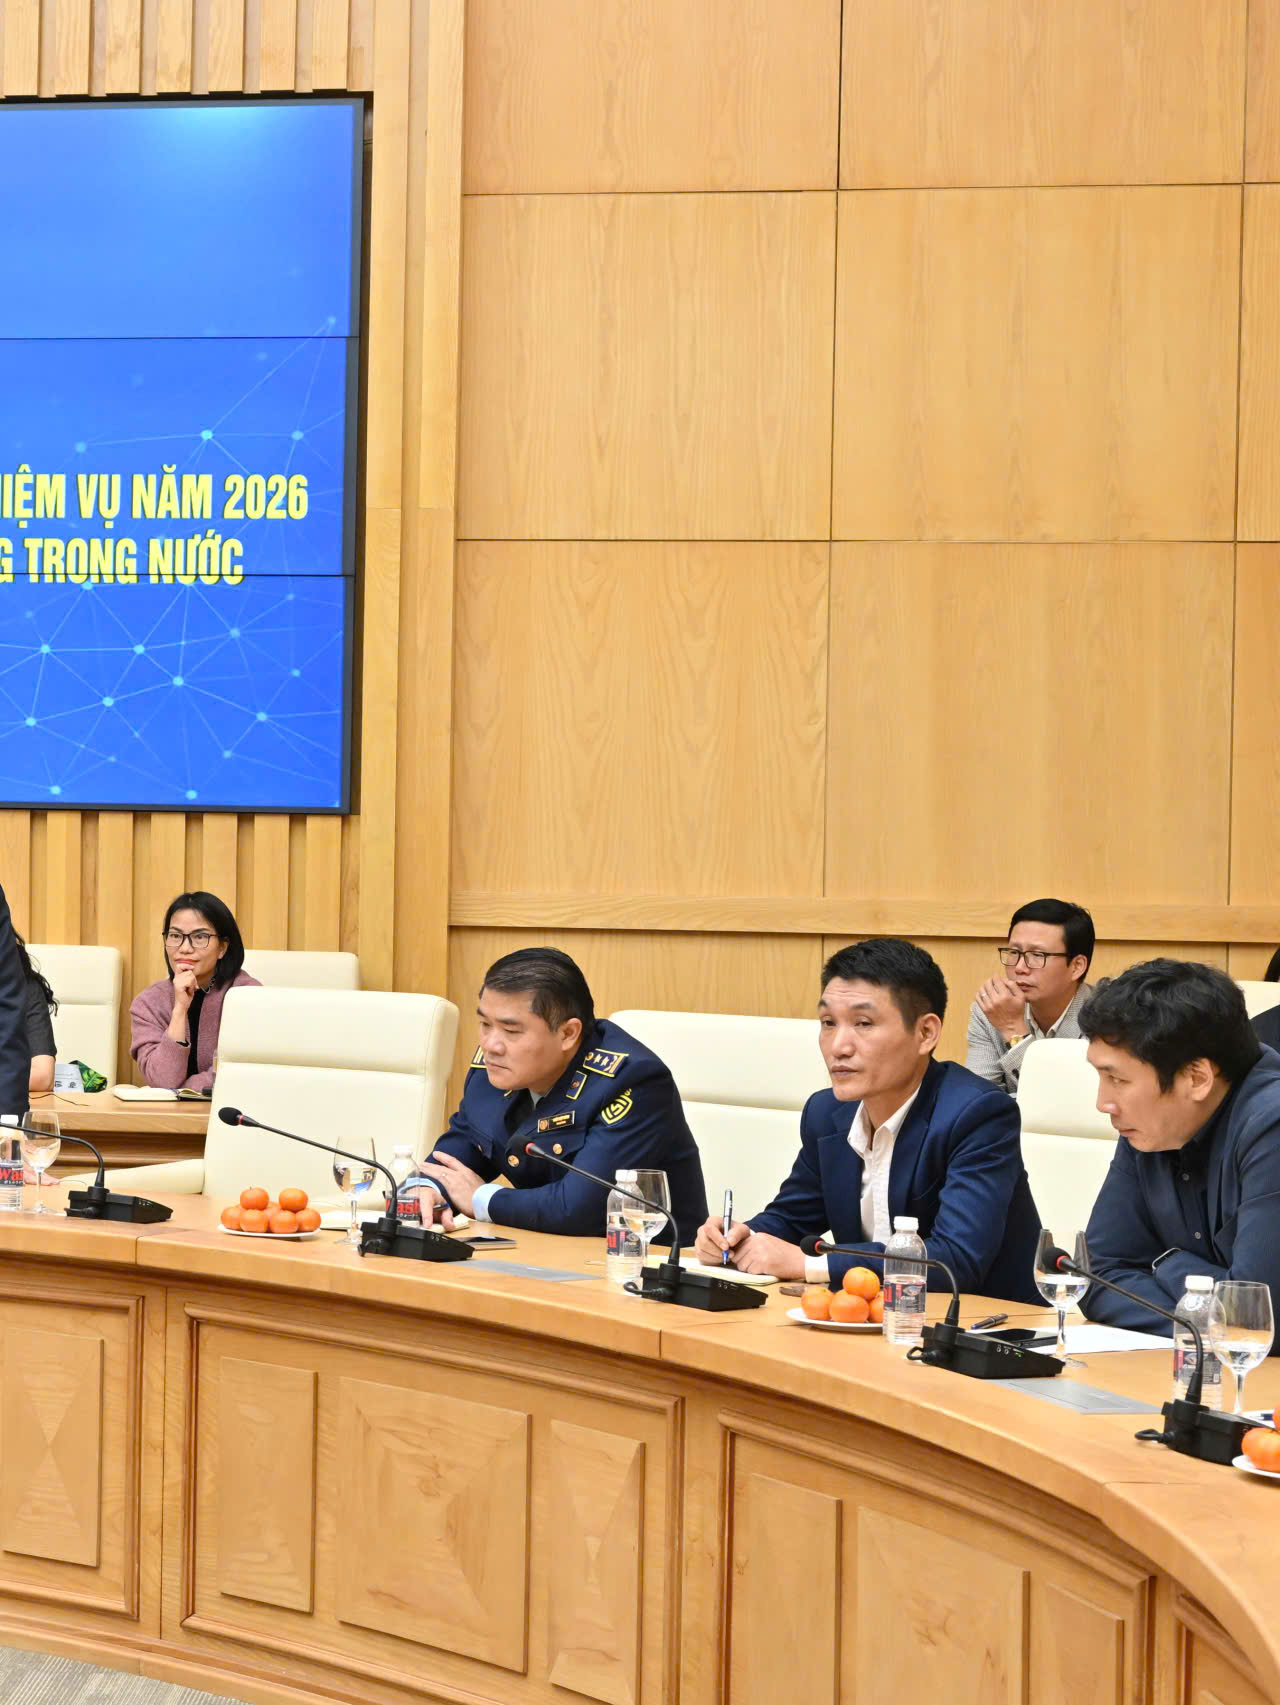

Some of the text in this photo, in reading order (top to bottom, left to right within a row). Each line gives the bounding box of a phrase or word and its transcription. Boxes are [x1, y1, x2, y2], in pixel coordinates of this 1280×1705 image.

[77, 473, 120, 529] VỤ
[132, 464, 212, 519] NĂM
[223, 474, 308, 520] 2026
[23, 537, 138, 584] TRONG
[148, 529, 243, 585] NƯỚC
